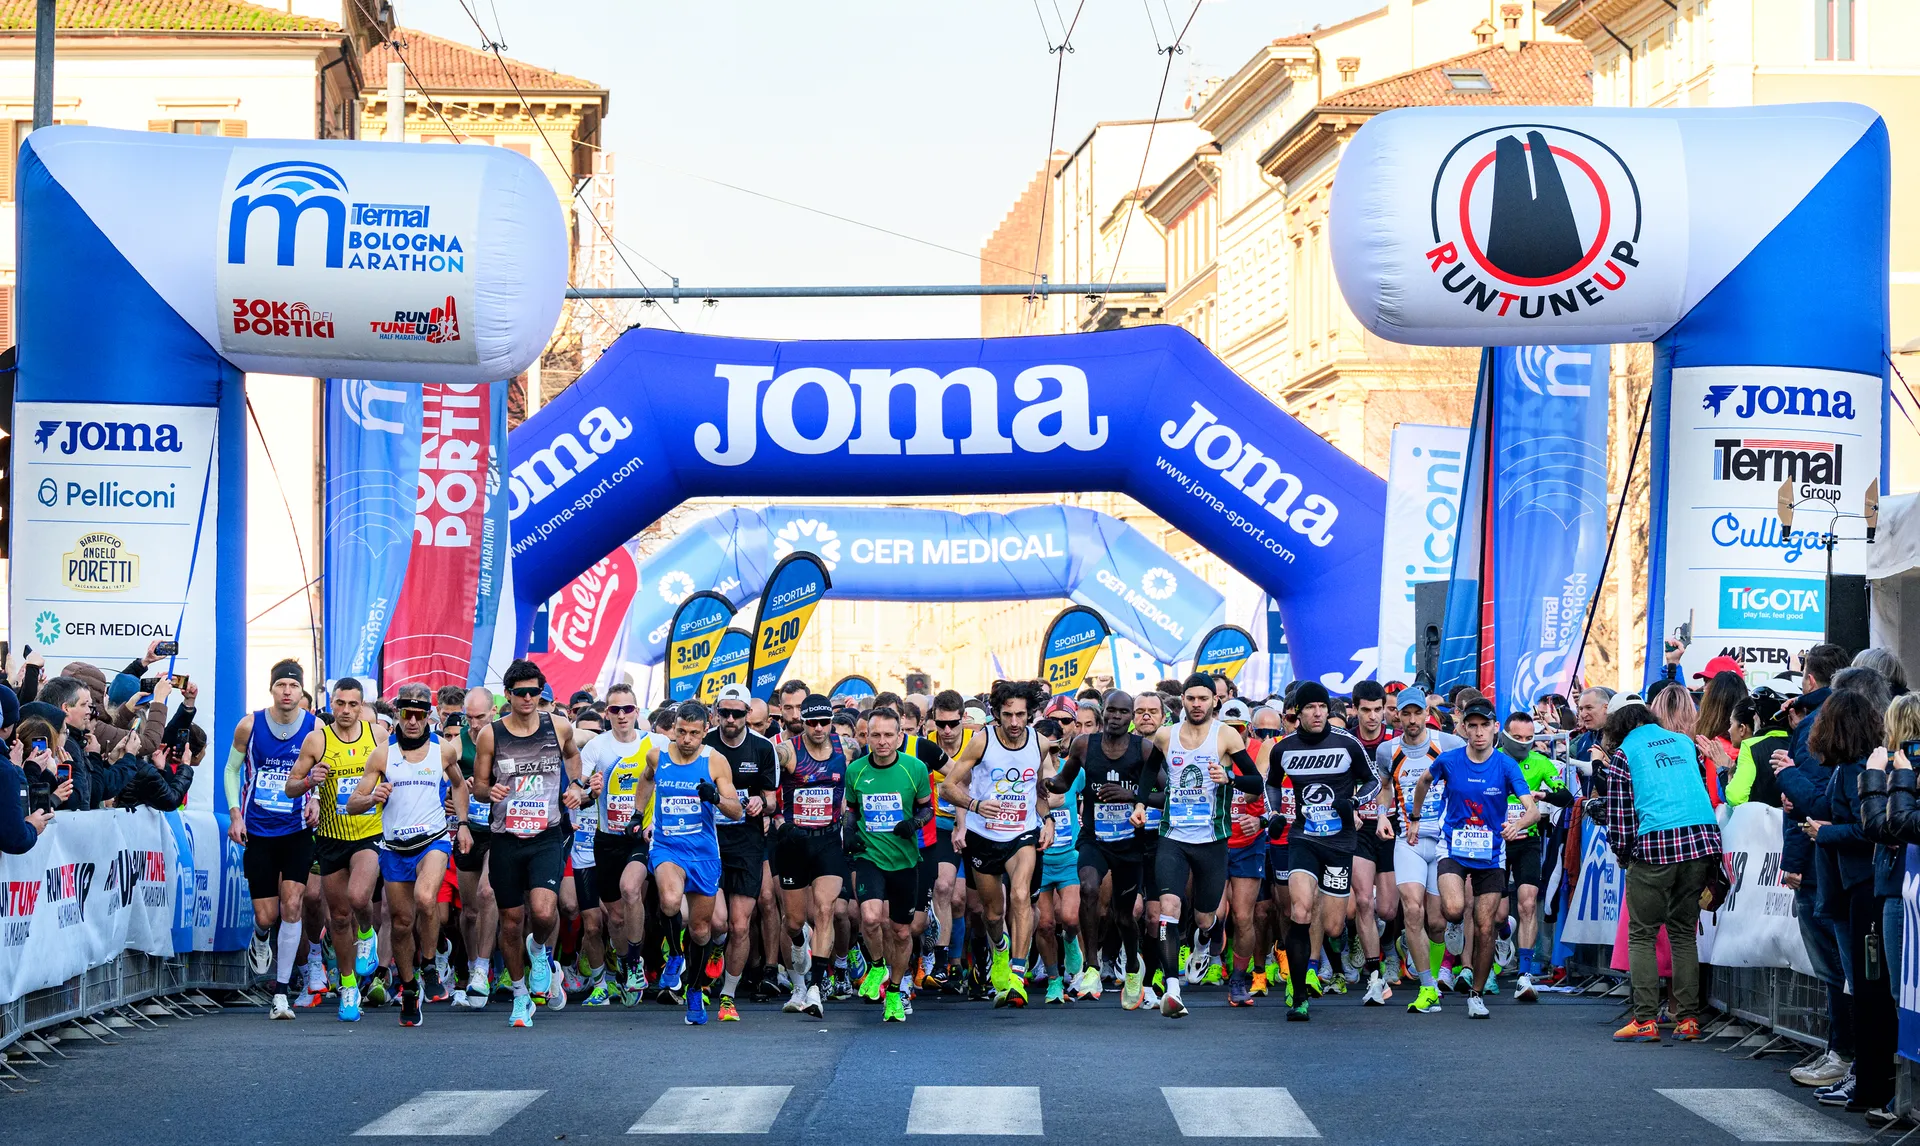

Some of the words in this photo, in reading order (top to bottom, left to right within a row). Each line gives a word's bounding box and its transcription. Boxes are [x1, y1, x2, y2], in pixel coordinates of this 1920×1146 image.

[351, 203, 430, 229] Termal
[348, 231, 464, 253] BOLOGNA
[312, 311, 333, 322] DEI
[394, 310, 430, 323] RUN
[234, 318, 335, 339] PORTICI
[379, 333, 394, 341] HALF
[395, 334, 426, 342] MARATHON
[434, 384, 481, 548] PORTI
[508, 405, 633, 522] oma
[1714, 439, 1843, 486] Termal
[66, 481, 176, 509] Pelliconi
[1800, 484, 1842, 504] Group
[1155, 455, 1297, 565] www.joma-sport.com
[79, 534, 122, 549] BIRRIFICIO
[482, 518, 496, 571] MARATHON
[850, 538, 914, 564] CER
[922, 533, 1064, 565] MEDICAL
[83, 547, 116, 559] ANGELO
[69, 559, 132, 583] PORETTI
[481, 571, 493, 597] HALF
[772, 582, 816, 607] SPORTLAB
[1096, 569, 1127, 597] CER
[1123, 589, 1184, 641] MEDICAL
[680, 612, 723, 632] SPORTLAB
[1540, 596, 1560, 649] Termal
[1743, 611, 1758, 619] play
[1758, 611, 1772, 619] fair,
[65, 622, 96, 636] CER
[99, 623, 174, 637] MEDICAL
[762, 617, 800, 651] 2:00
[1054, 629, 1096, 649] SPORTLAB
[677, 639, 711, 664] 3:00
[712, 647, 750, 666] SPORTLAB
[767, 646, 787, 658] PACER
[1207, 645, 1246, 659] SPORTLAB
[682, 662, 700, 671] PACER
[1049, 657, 1079, 683] 2:15
[1055, 680, 1072, 689] PACER
[1287, 754, 1345, 770] BADBOY
[337, 767, 355, 776] EDIL
[356, 766, 365, 774] PA
[270, 793, 278, 802] 4
[801, 808, 826, 817] 3145
[1186, 807, 1193, 816] 5
[1364, 803, 1378, 811] 30
[512, 820, 541, 830] 3089
[616, 814, 632, 823] 313
[678, 817, 685, 826] 8
[873, 814, 895, 823] 404
[1112, 824, 1118, 832] 1
